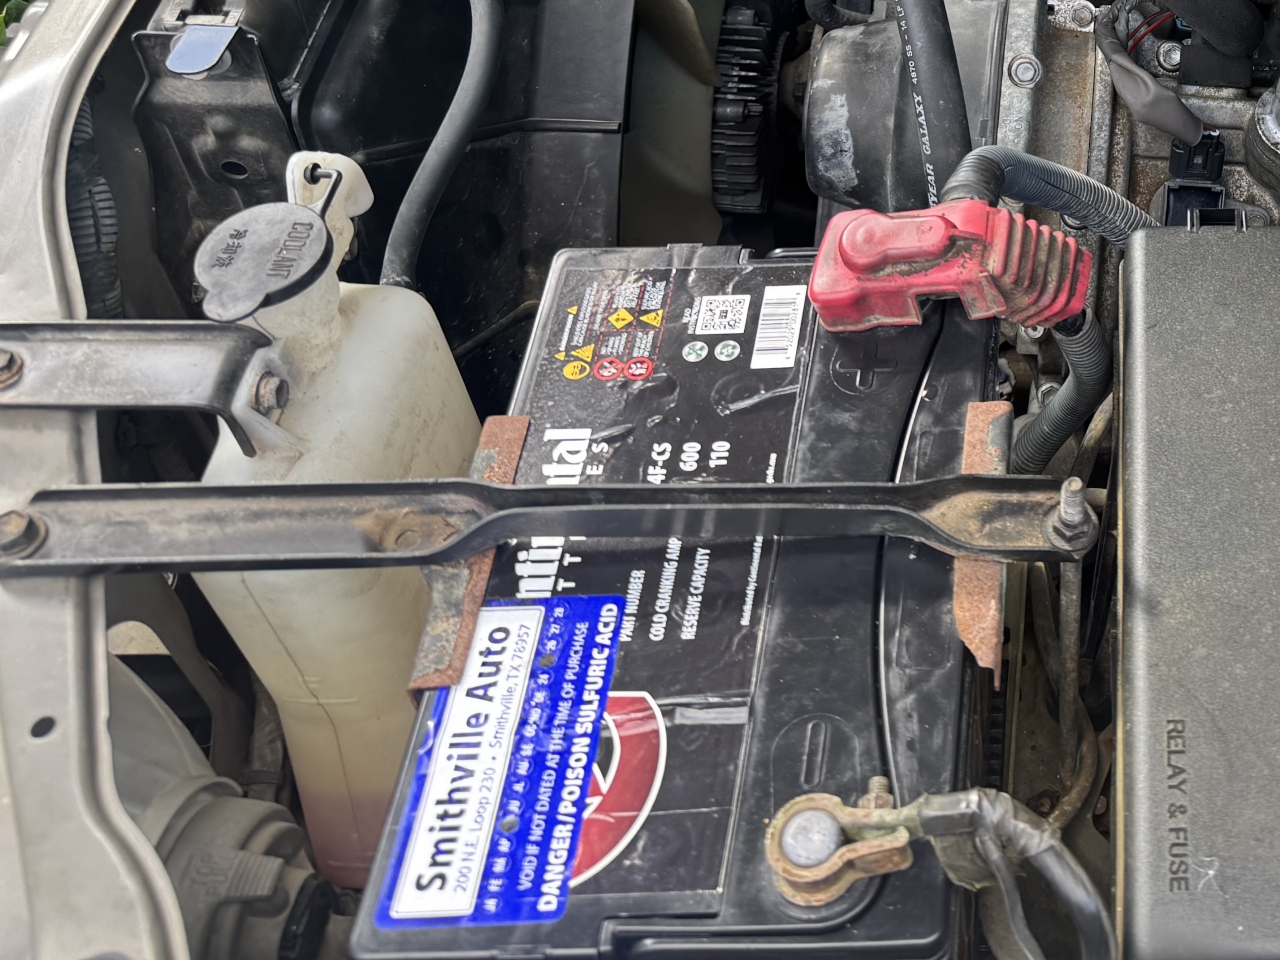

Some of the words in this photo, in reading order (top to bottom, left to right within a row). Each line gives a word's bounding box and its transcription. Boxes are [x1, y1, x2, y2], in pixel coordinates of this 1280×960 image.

[896, 5, 905, 16] LP
[900, 20, 908, 30] 14
[905, 45, 913, 57] SS
[913, 92, 932, 154] GALAXY
[266, 221, 313, 279] COOLANT
[678, 442, 702, 472] 600
[709, 441, 731, 468] 110
[690, 547, 712, 593] CAPACITY
[624, 570, 646, 613] NUMBER
[654, 561, 679, 613] CRANKING
[648, 613, 668, 641] COLD
[681, 588, 705, 640] RESERVE
[511, 624, 532, 661] 78957
[564, 621, 589, 680] PURCHASE
[506, 663, 521, 682] TX
[560, 681, 577, 698] OF
[488, 683, 521, 749] Smithville,
[554, 701, 572, 726] TIME
[546, 726, 566, 751] THE
[414, 712, 490, 892] Smithville
[465, 625, 512, 702] Auto
[538, 737, 591, 912] DANGER/POISON
[574, 647, 611, 733] SULFURIC
[595, 603, 619, 645] ACID
[544, 752, 560, 768] AT
[1167, 719, 1188, 795] RELAY
[479, 767, 497, 793] 230
[534, 770, 557, 811] DATED
[469, 796, 496, 832] Loop
[1168, 802, 1188, 819] &
[527, 813, 547, 842] NOT
[525, 843, 540, 854] IF
[1168, 827, 1189, 893] FUSE
[454, 866, 473, 893] 200
[518, 855, 539, 890] VOID
